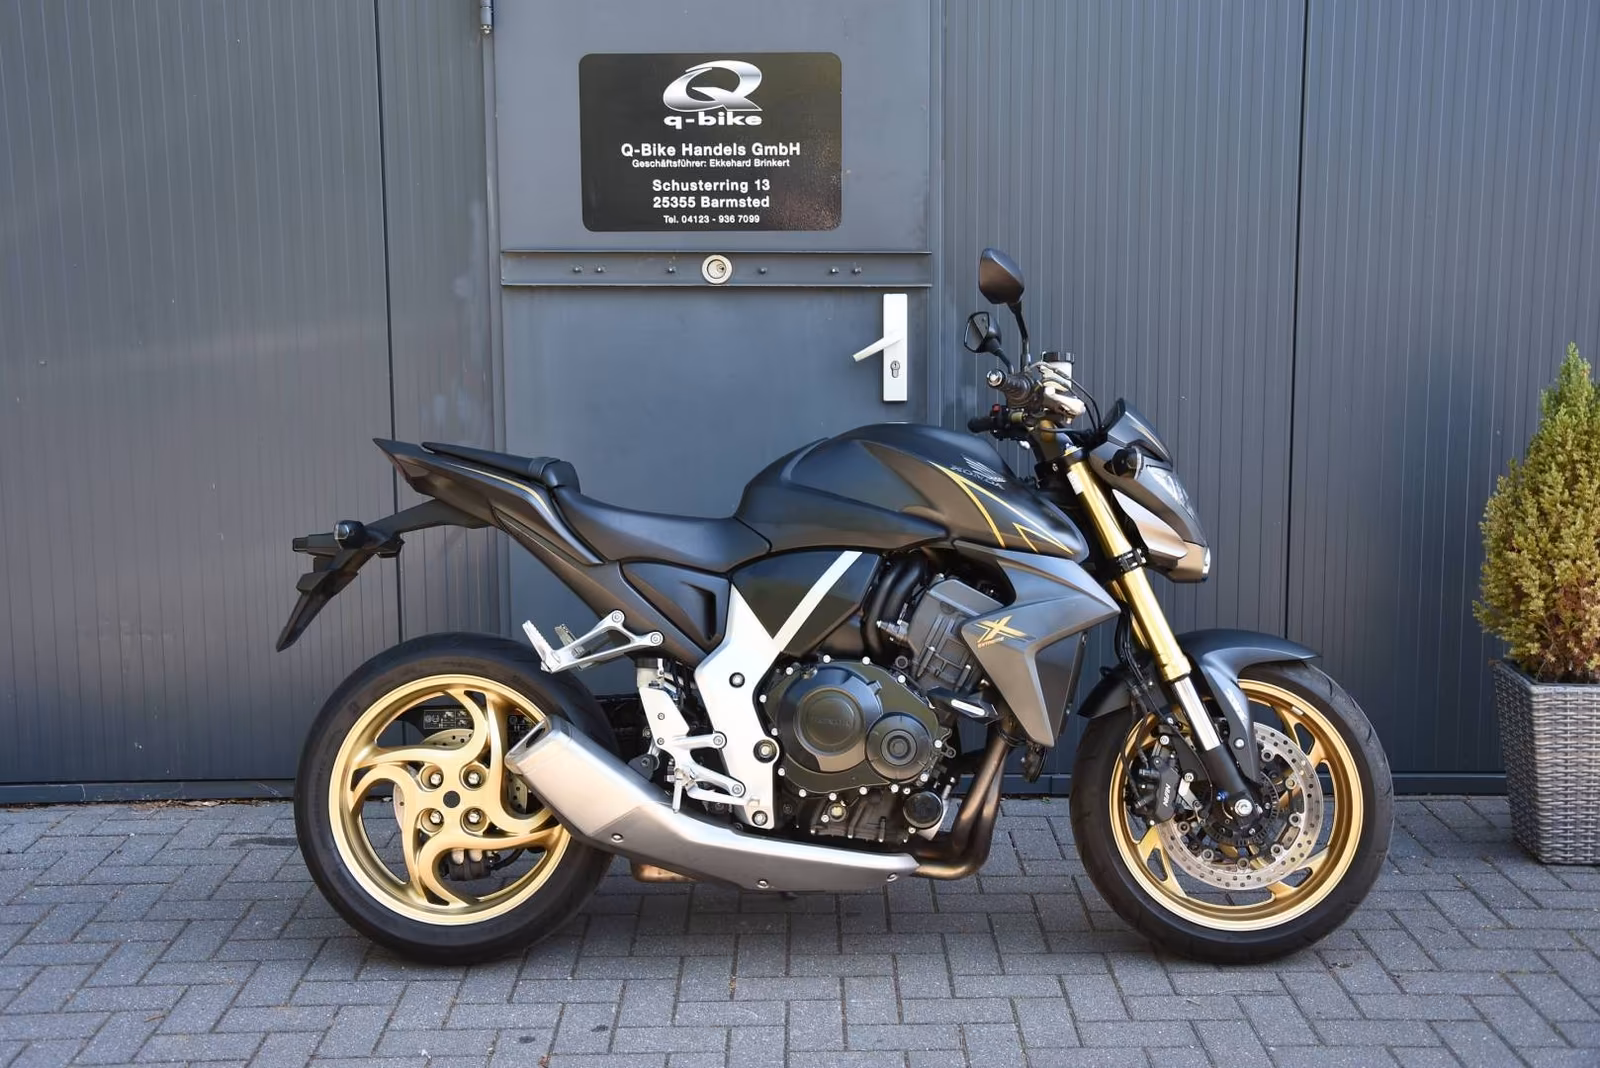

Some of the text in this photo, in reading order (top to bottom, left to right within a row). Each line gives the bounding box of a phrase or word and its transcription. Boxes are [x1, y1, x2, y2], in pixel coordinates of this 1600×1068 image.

[664, 112, 762, 129] q-bike
[621, 142, 801, 157] Q-Bike Handels GmbH
[631, 158, 790, 168] Geschäftsführer: Ekkehard Brinkert
[652, 179, 770, 194] Schusterring 13
[653, 195, 770, 209] 25355 Barmsted
[663, 215, 679, 224] Tel.
[681, 215, 710, 224] 04123
[718, 215, 736, 224] 936
[737, 215, 760, 224] 7099
